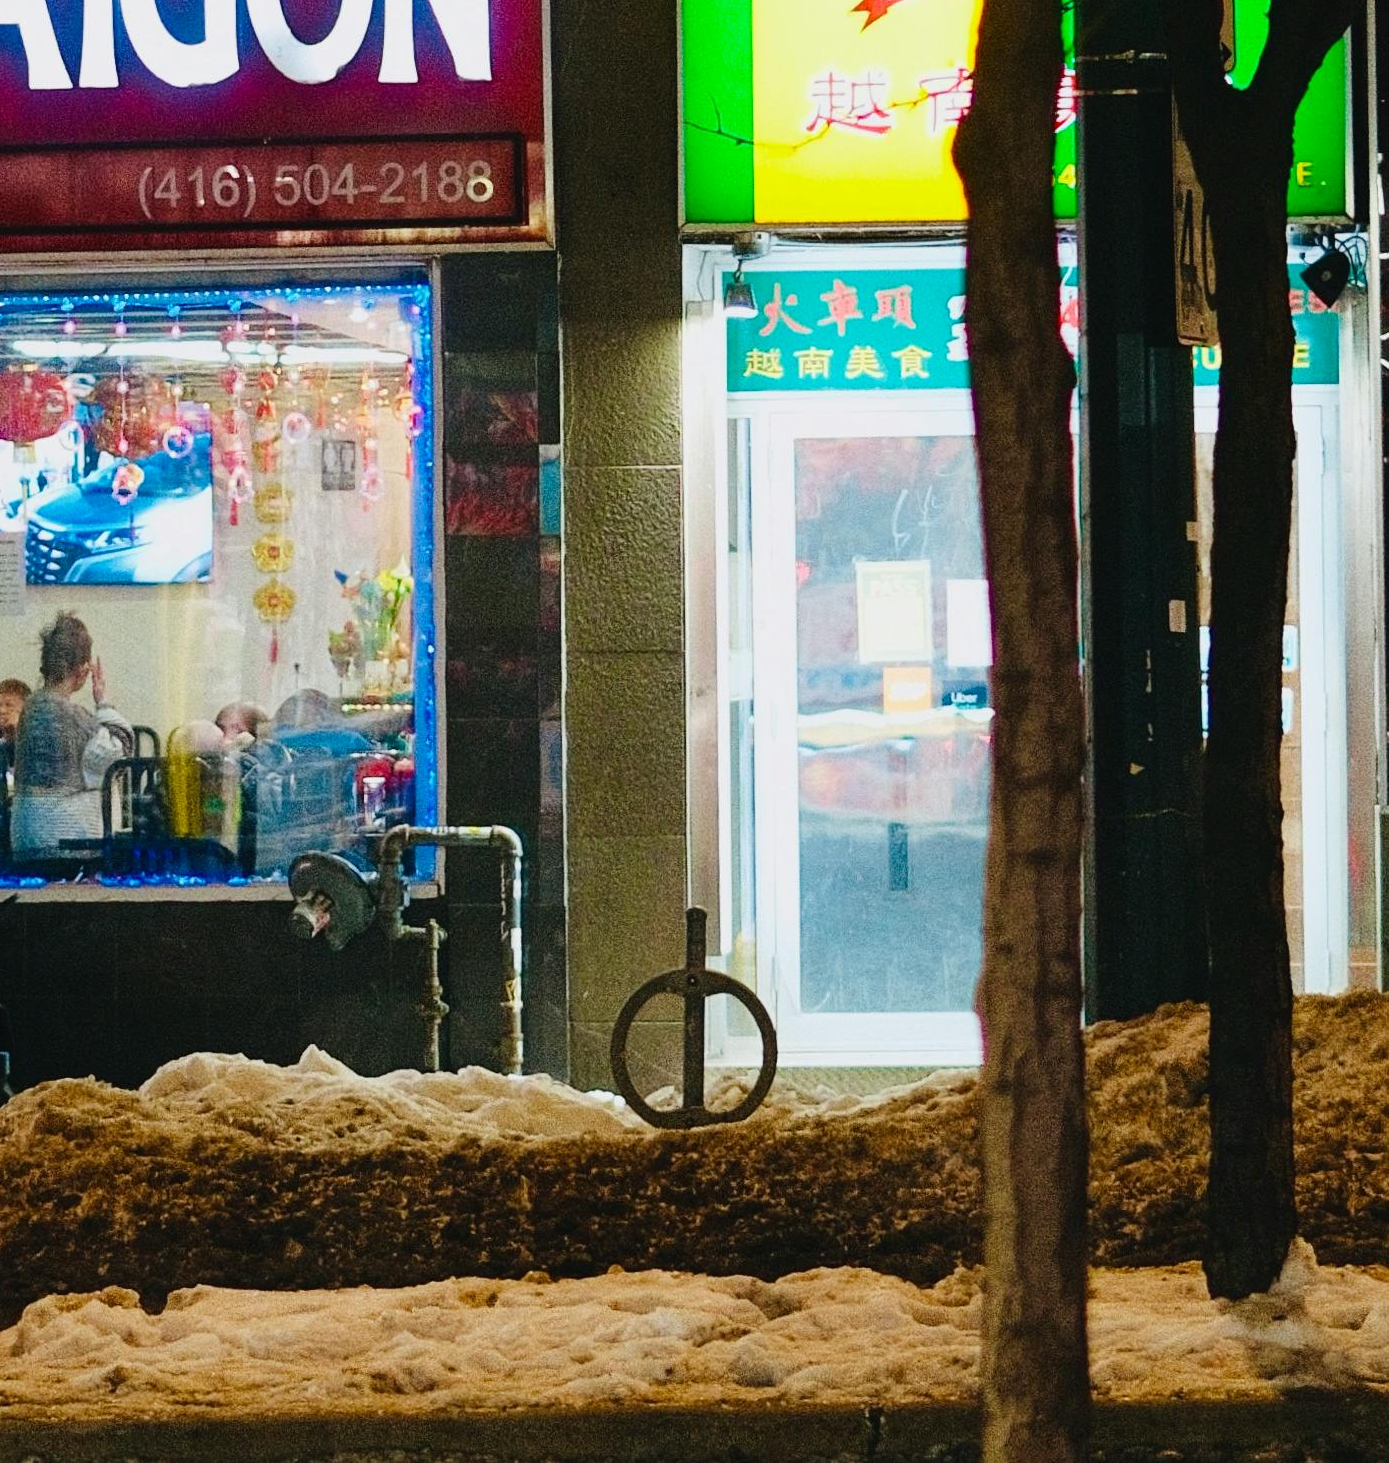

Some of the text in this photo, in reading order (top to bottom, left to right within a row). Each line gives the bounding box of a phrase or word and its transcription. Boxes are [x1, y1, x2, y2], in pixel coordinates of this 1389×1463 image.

[138, 159, 495, 220] (416) 504-2188
[743, 345, 932, 380] 越南美食
